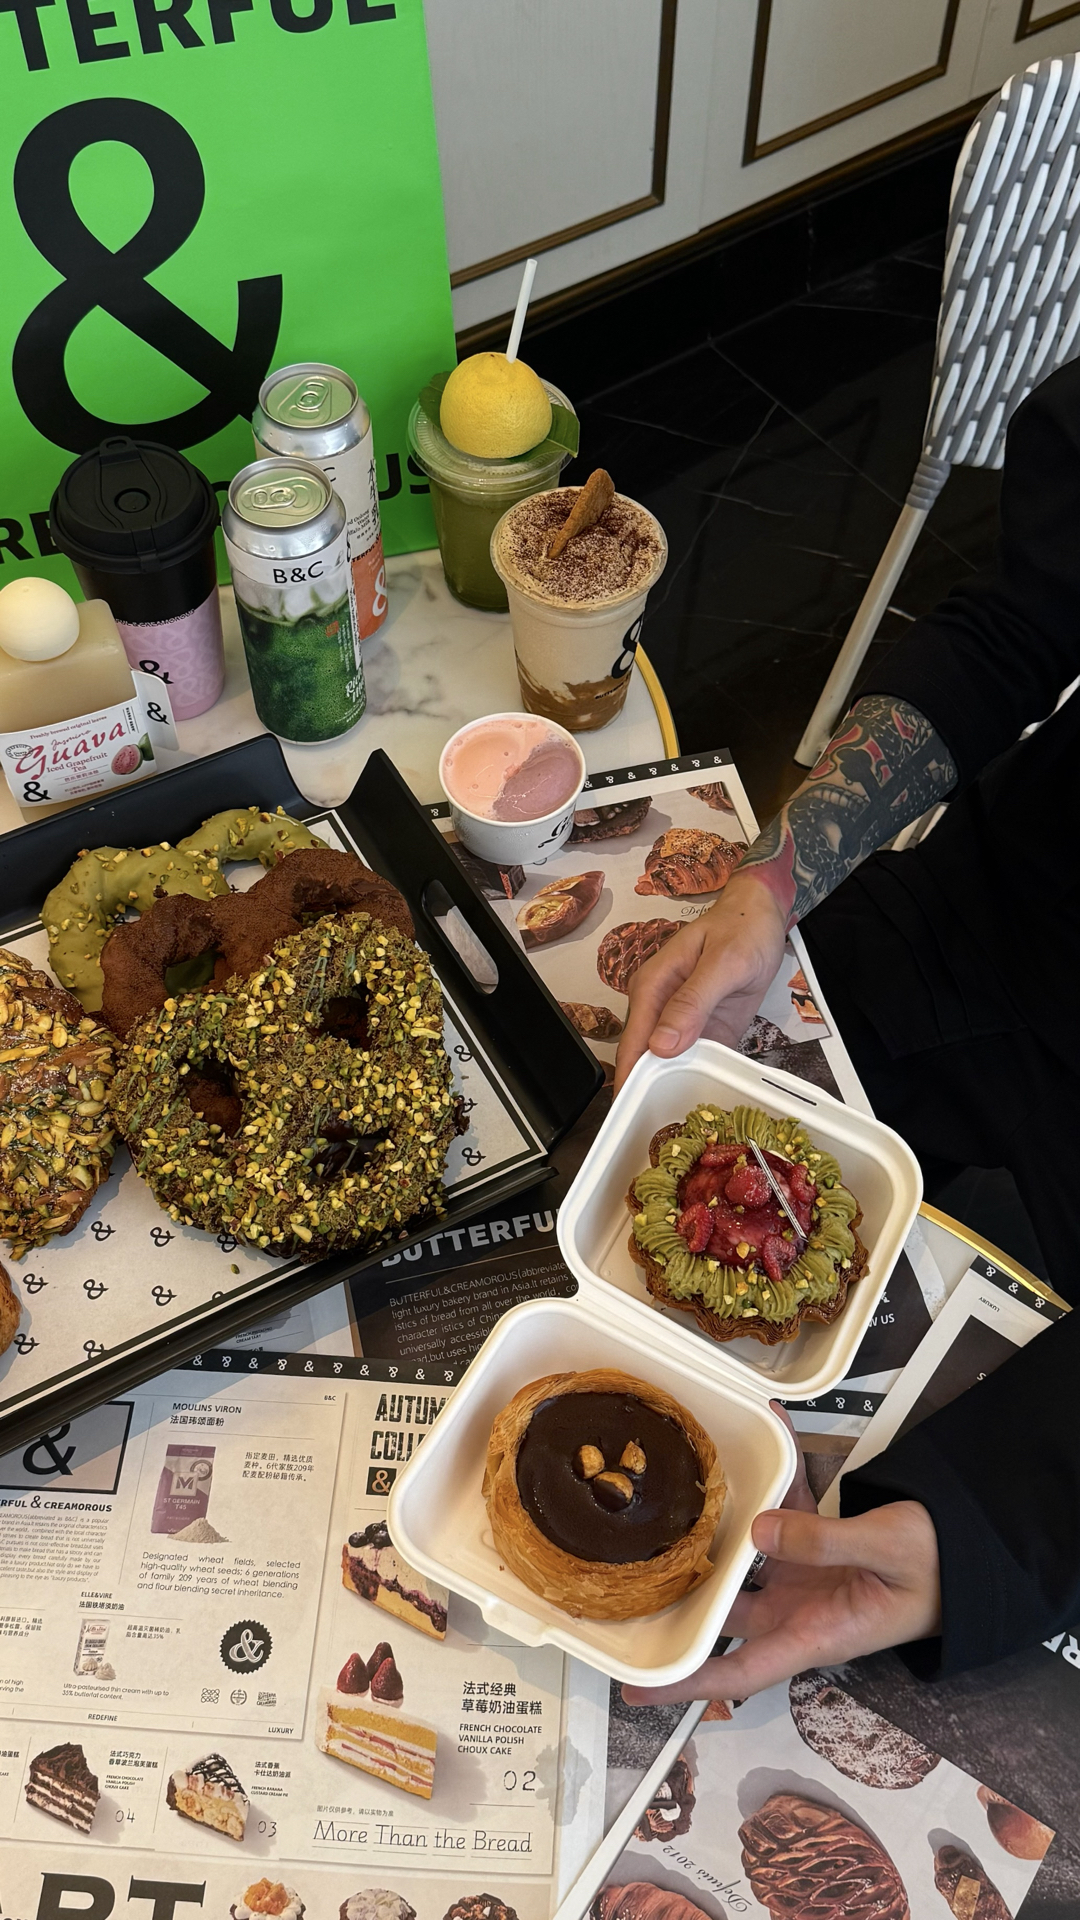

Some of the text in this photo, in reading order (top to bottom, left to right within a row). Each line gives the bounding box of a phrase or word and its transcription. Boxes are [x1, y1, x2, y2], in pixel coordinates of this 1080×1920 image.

[0, 0, 397, 72] TERF
[273, 560, 324, 584] B&C
[15, 722, 126, 780] Guava
[46, 752, 108, 773] Iced Grapefruit
[71, 765, 87, 773] Tea
[382, 1210, 560, 1268] UTTERFU
[389, 1261, 567, 1308] BUTTERFUL&CREAMOROUS(abbreviate
[391, 1308, 412, 1320] light
[413, 1302, 440, 1314] luxury
[442, 1295, 471, 1308] bakery
[473, 1287, 499, 1300] brand
[501, 1285, 509, 1294] in
[540, 1273, 569, 1286] retains
[395, 1320, 417, 1331] istics
[420, 1314, 428, 1326] of
[431, 1309, 457, 1323] bread
[459, 1304, 479, 1316] from
[482, 1302, 492, 1311] all
[495, 1298, 513, 1308] over
[516, 1294, 530, 1304] the
[881, 1313, 895, 1325] US
[397, 1312, 504, 1344] character istics of Chin
[400, 1327, 492, 1356] universally accessibl
[447, 1346, 467, 1358] uses
[172, 1402, 242, 1414] MOULINS VIRON
[374, 1393, 449, 1425] AUTUM
[44, 1501, 113, 1512] CREAMOROUS
[143, 1552, 189, 1562] Designated
[198, 1555, 224, 1564] wheat
[266, 1560, 301, 1569] selected
[141, 1562, 187, 1573] high-quality
[190, 1565, 215, 1574] wheat
[252, 1569, 300, 1579] generations
[137, 1581, 285, 1599] and flour blending secret inheritance.
[139, 1572, 298, 1590] of family 209 years of wheat blending
[80, 1591, 113, 1599] ELLE&VIRE
[462, 1680, 516, 1697] 法式经典
[461, 1698, 542, 1715] 草莓奶油蛋糕
[88, 1713, 118, 1722] REDEFINE
[268, 1726, 294, 1734] LUXURY
[459, 1723, 542, 1734] FRENCH CHOCOLATE
[458, 1734, 524, 1744] VANILLA POLISH
[457, 1745, 512, 1755] CHOUX CAKE
[503, 1770, 536, 1791] 02
[312, 1819, 533, 1853] More Than the Bread
[662, 1844, 696, 1869] 2012
